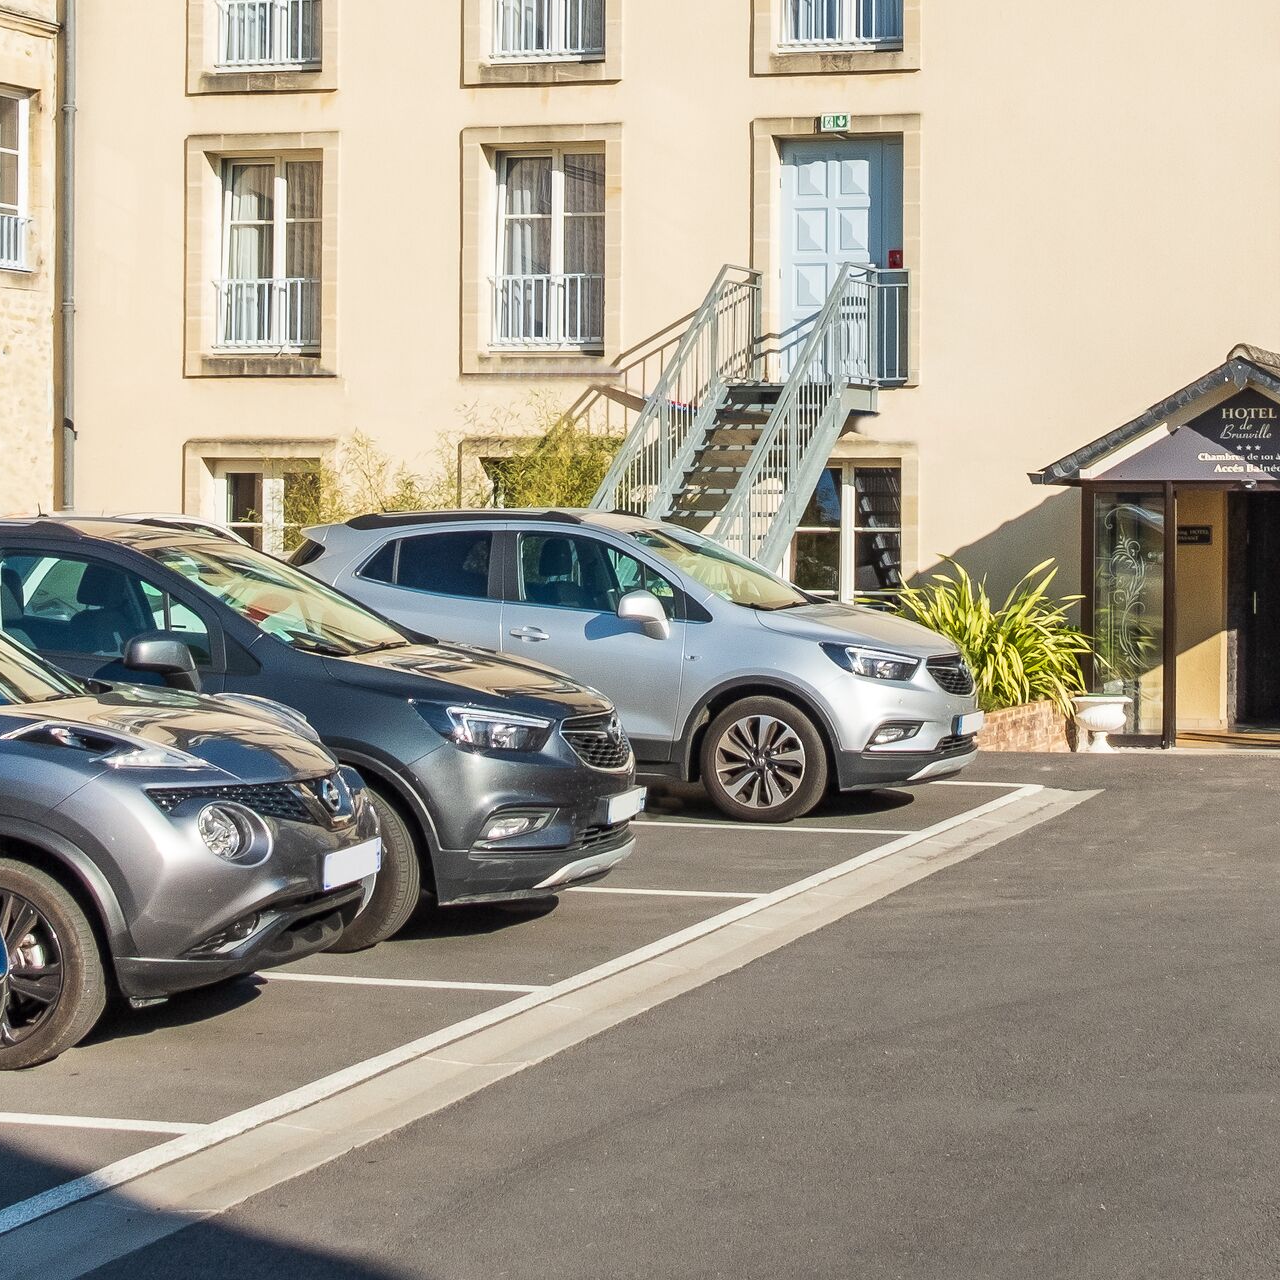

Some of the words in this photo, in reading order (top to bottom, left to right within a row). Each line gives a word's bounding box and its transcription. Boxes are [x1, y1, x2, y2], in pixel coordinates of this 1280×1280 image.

[1221, 407, 1277, 419] HOTEL
[1239, 415, 1253, 430] de
[1220, 423, 1272, 439] Brunville
[1197, 452, 1245, 461] Chambres
[1247, 453, 1259, 461] de
[1275, 452, 1280, 461] à
